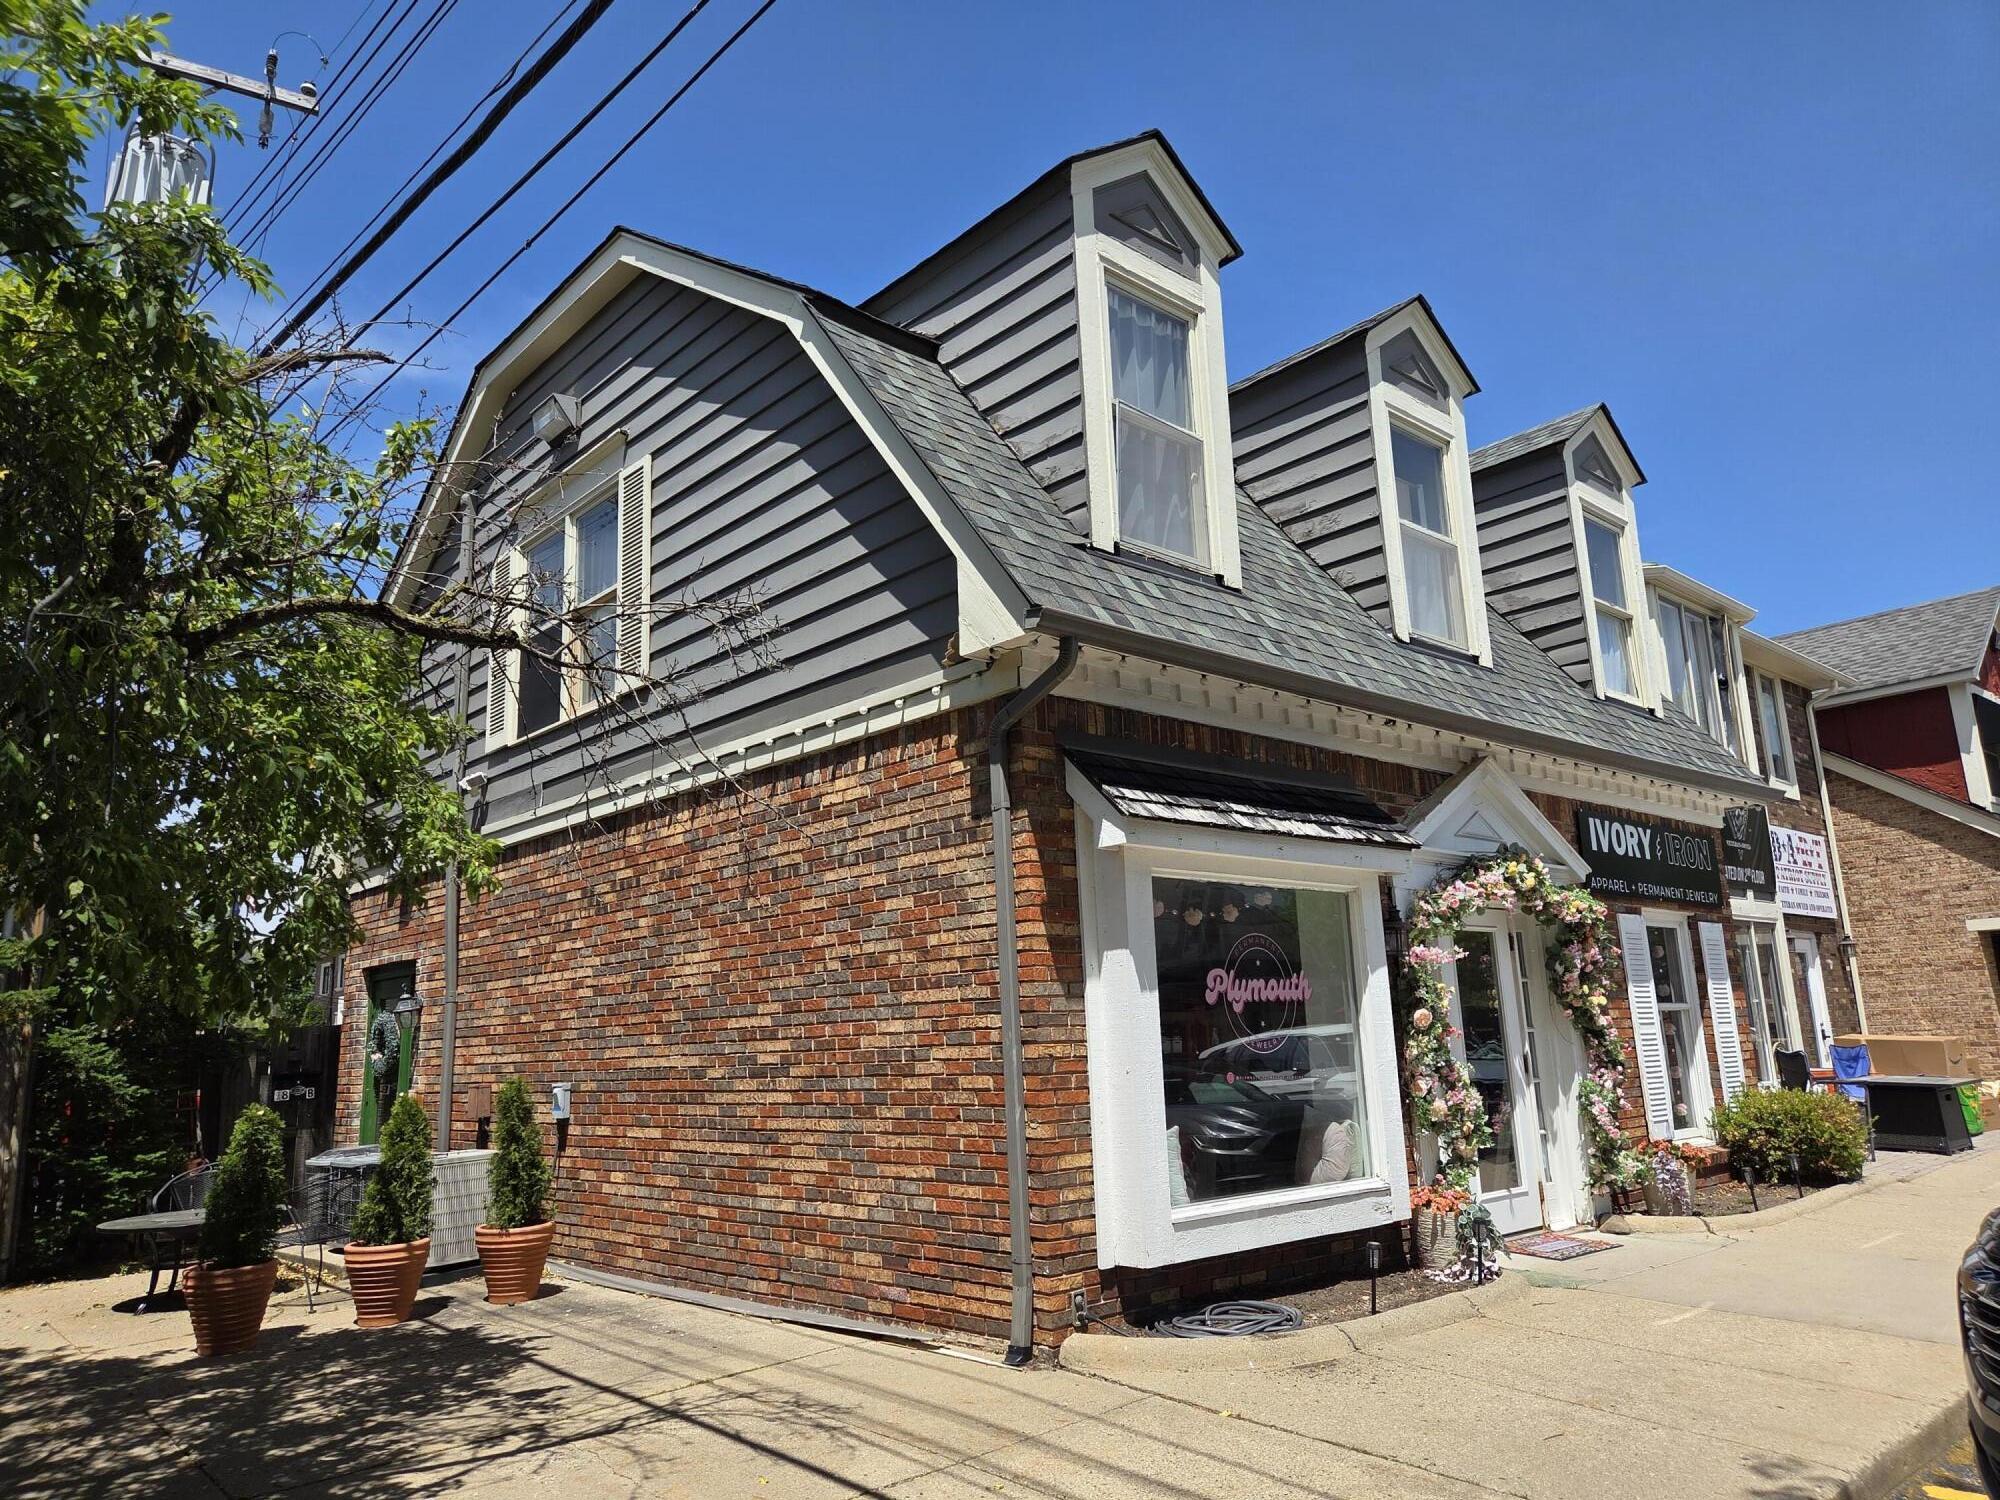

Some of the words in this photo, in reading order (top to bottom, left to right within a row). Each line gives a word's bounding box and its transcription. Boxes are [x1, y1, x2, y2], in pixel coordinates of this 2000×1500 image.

[1588, 817, 1651, 860] IVORY
[1656, 834, 1662, 861] &
[1664, 832, 1712, 871] IRON
[1591, 877, 1630, 893] APPAREL
[1638, 882, 1685, 899] PERMANENT
[1685, 889, 1718, 905] JEWELRY
[1205, 967, 1312, 1013] Plymouth
